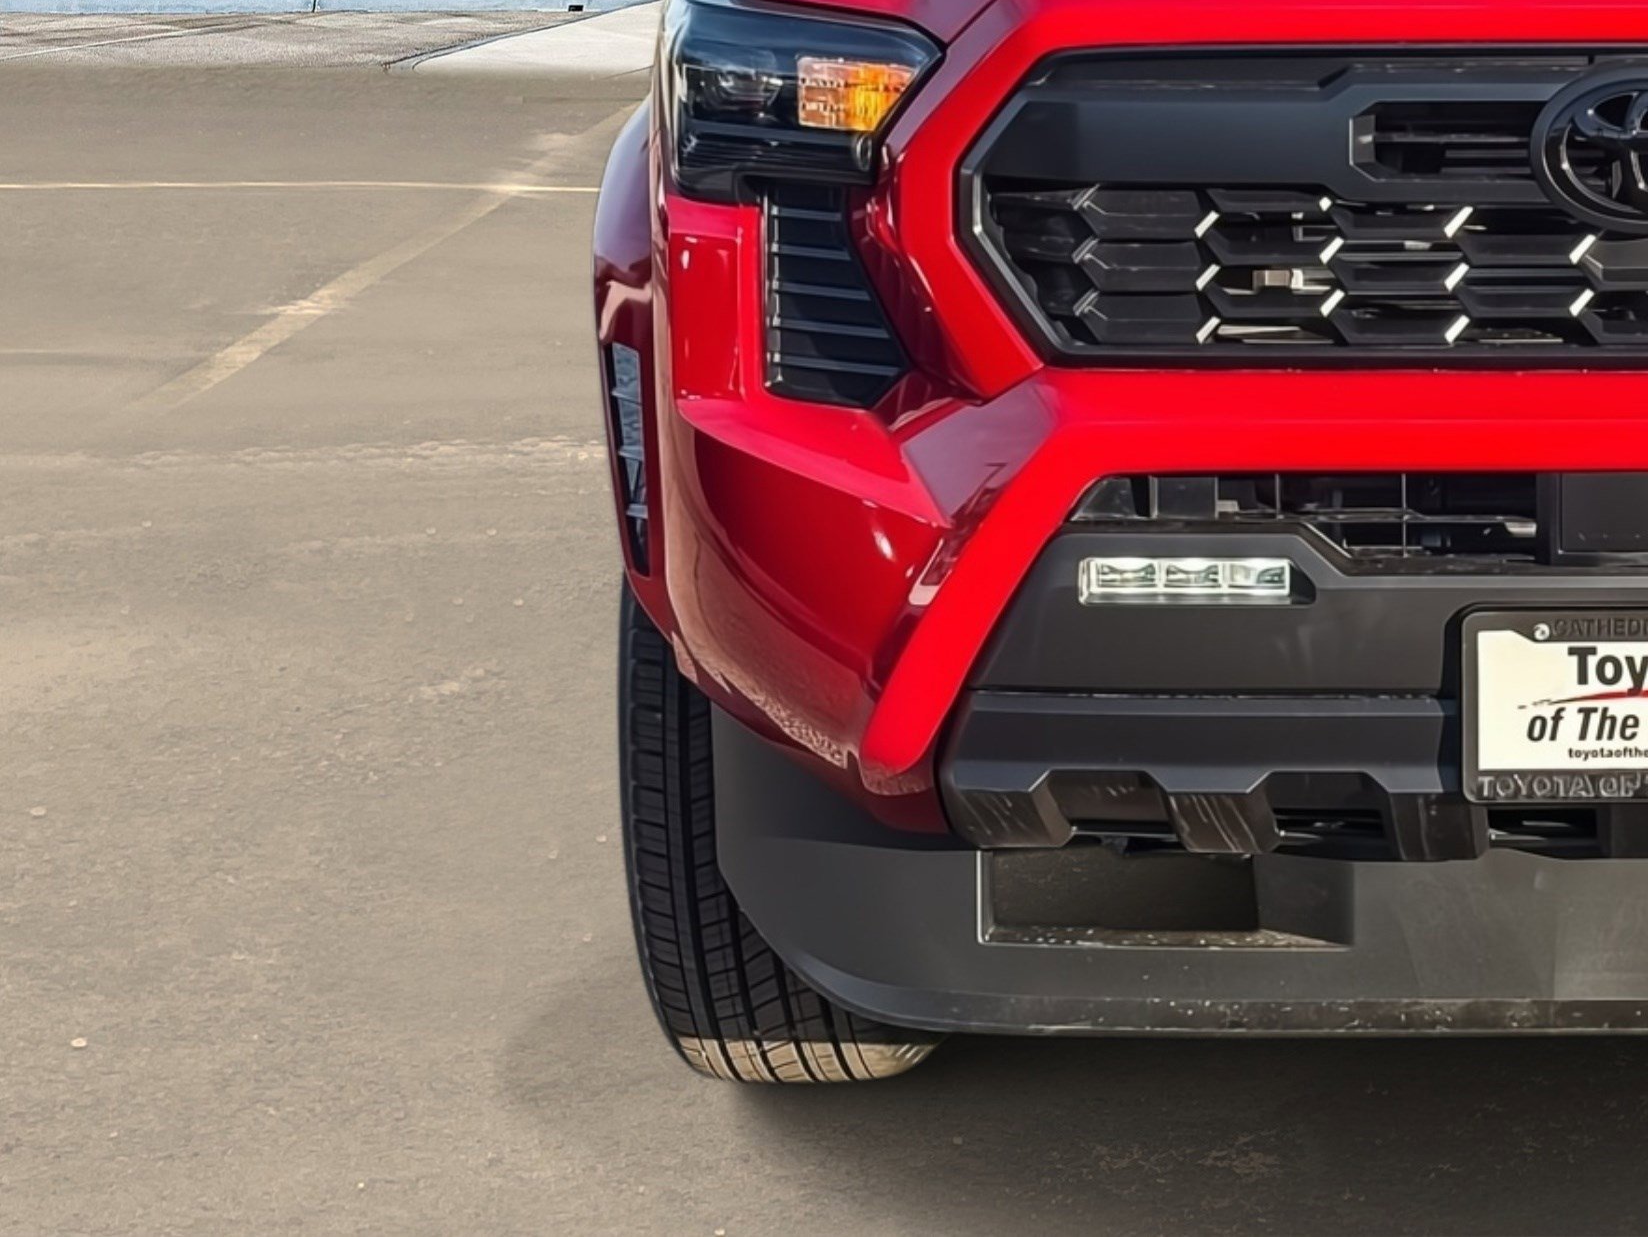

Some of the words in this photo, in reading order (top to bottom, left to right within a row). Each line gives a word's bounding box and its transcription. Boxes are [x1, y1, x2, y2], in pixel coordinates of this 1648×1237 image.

[1526, 707, 1565, 741] of
[1576, 706, 1640, 741] The
[1476, 774, 1594, 798] TOYOTA
[1598, 774, 1640, 798] OF
